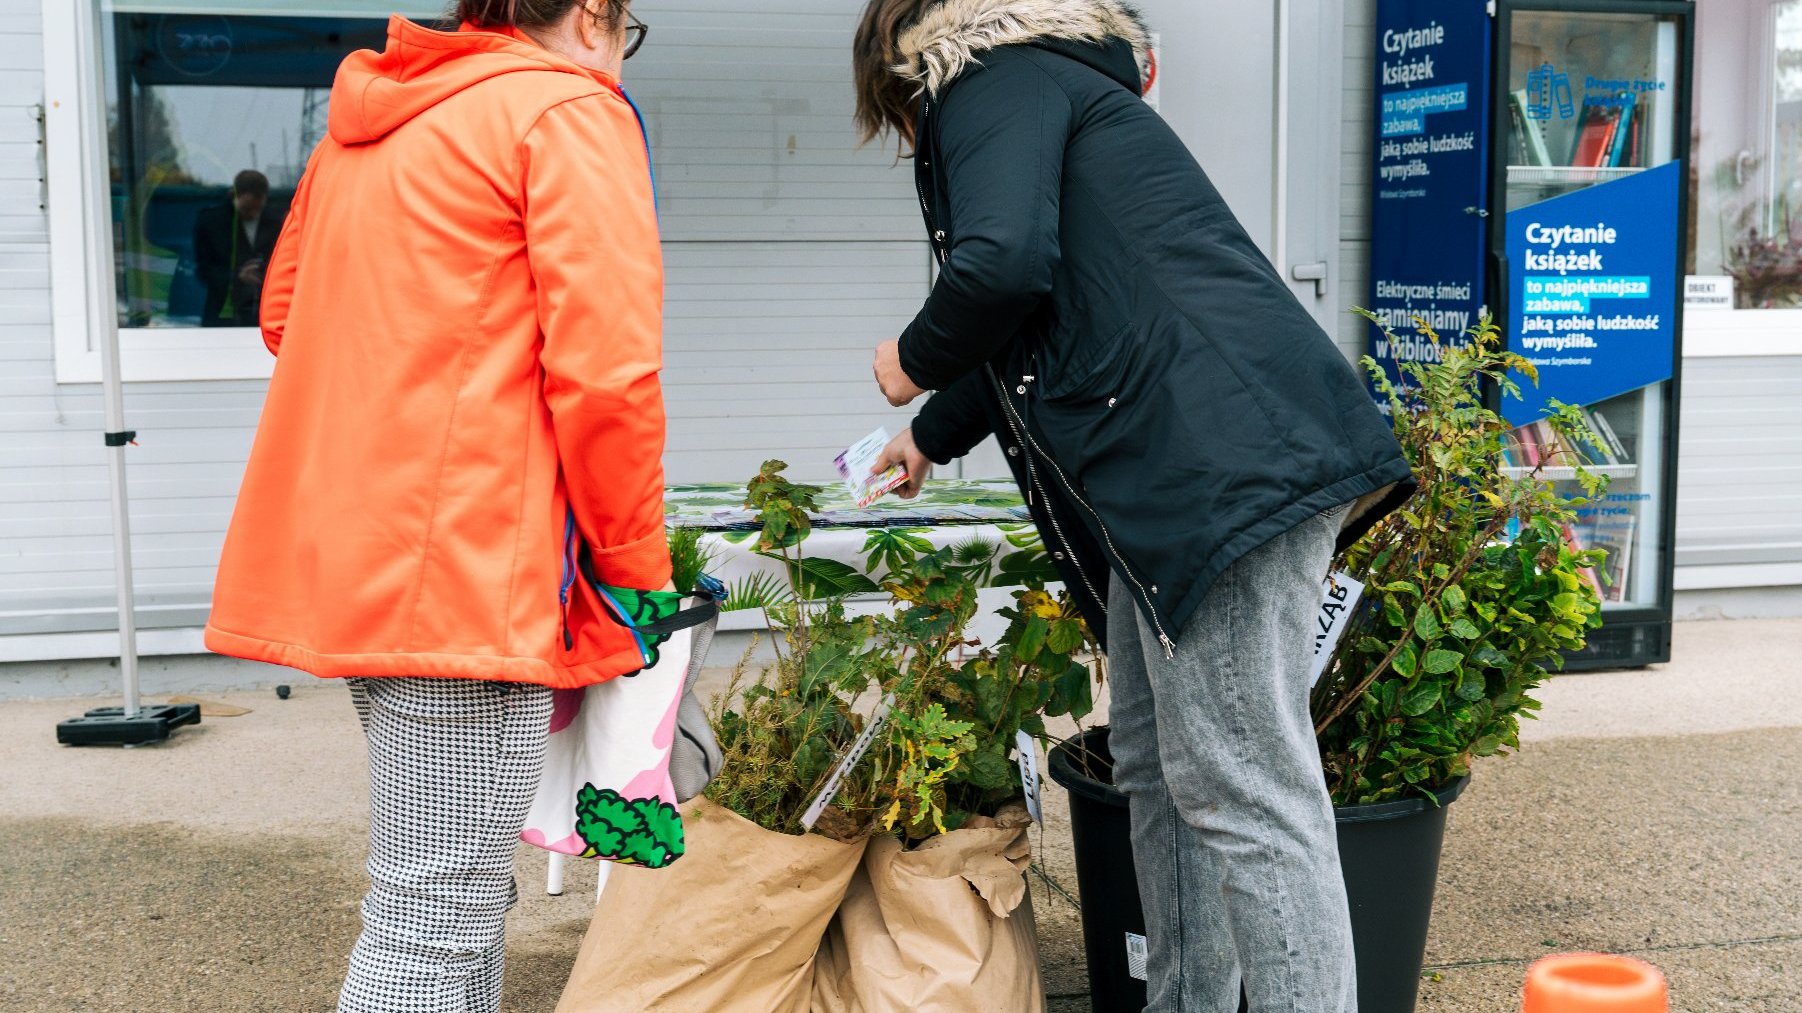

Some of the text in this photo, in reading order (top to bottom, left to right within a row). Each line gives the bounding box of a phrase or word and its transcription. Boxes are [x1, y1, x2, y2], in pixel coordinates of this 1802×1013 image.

[1383, 21, 1444, 57] Czytanie
[1382, 54, 1434, 89] książek
[1384, 88, 1465, 114] to najpiękniejsza
[1383, 118, 1421, 134] zabawa,
[1380, 131, 1474, 161] jaką sobie ludzkość
[1380, 159, 1430, 182] wymyśliła.
[1526, 222, 1617, 249] Czytanie
[1525, 248, 1603, 275] książek
[1376, 280, 1471, 303] Elektryczne śmieci
[1527, 278, 1648, 297] to najpiękniejsza
[1526, 296, 1584, 313] zabawa,
[1376, 302, 1470, 337] zamieniamy
[1521, 314, 1659, 334] jaką sobie ludzkość
[1376, 340, 1389, 359] w
[1522, 333, 1598, 352] wymyśliła.
[819, 716, 883, 809] Modrew
